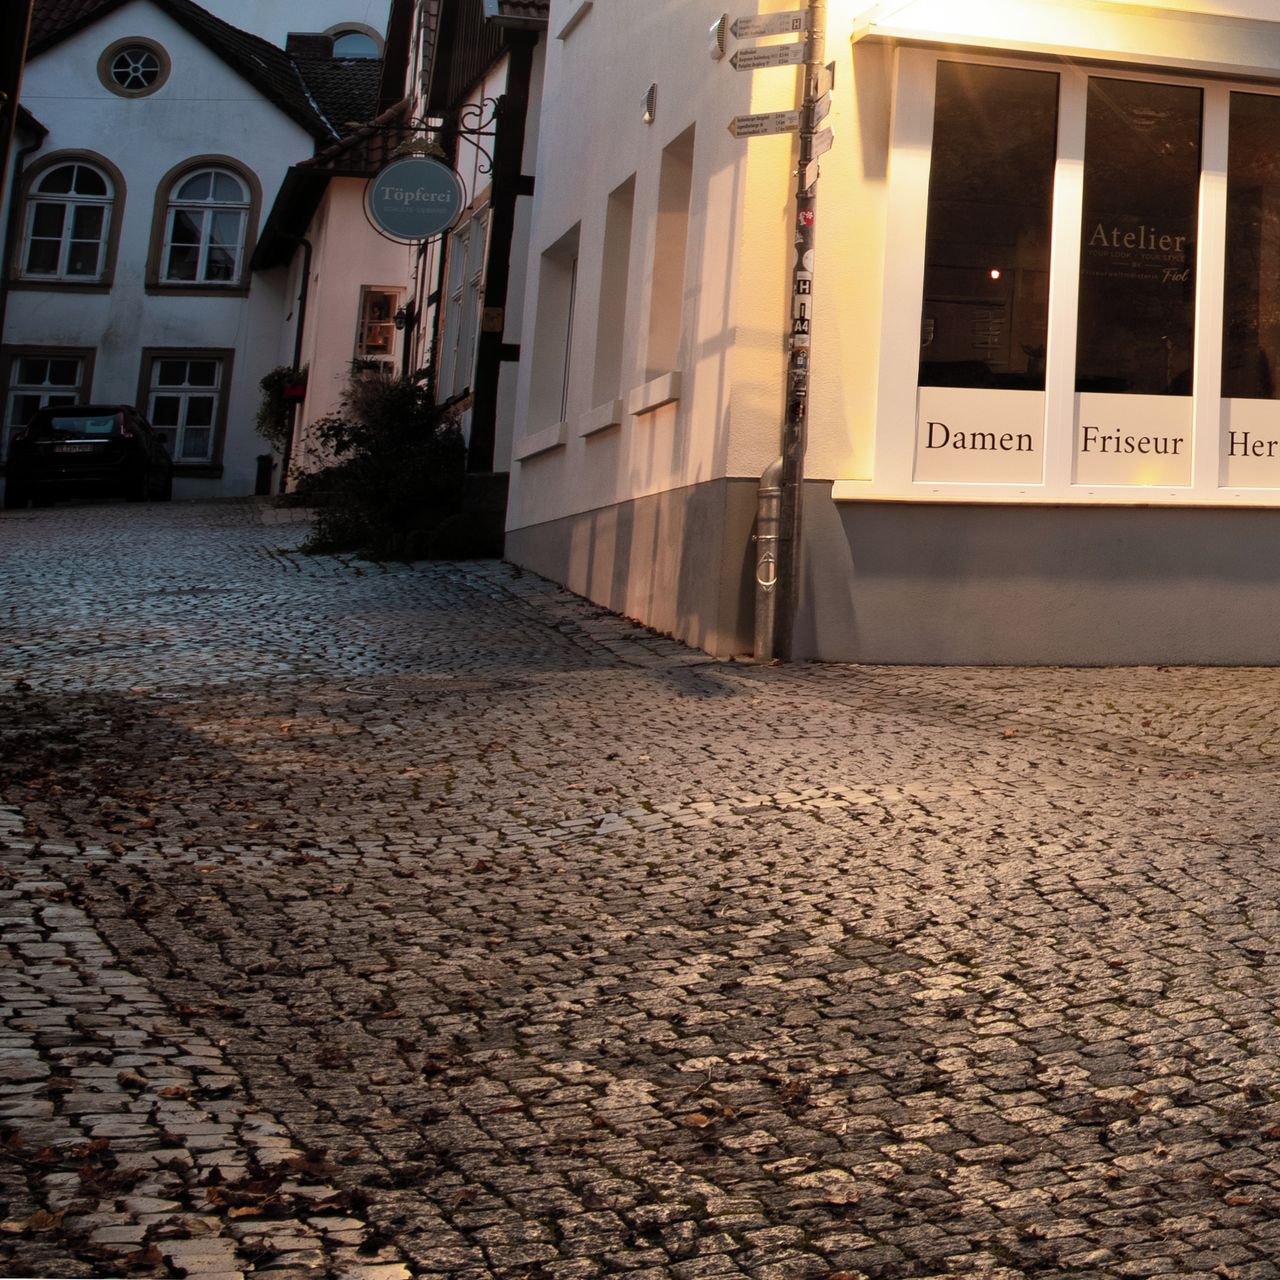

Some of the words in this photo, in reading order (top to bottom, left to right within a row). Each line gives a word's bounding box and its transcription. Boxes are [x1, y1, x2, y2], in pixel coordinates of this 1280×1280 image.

[380, 186, 452, 206] Töpferei
[1087, 223, 1186, 252] Atelier
[1162, 268, 1190, 283] Fiol
[799, 280, 810, 293] H
[794, 320, 808, 332] A4
[925, 422, 1034, 452] Damen
[1081, 425, 1184, 456] Friseur
